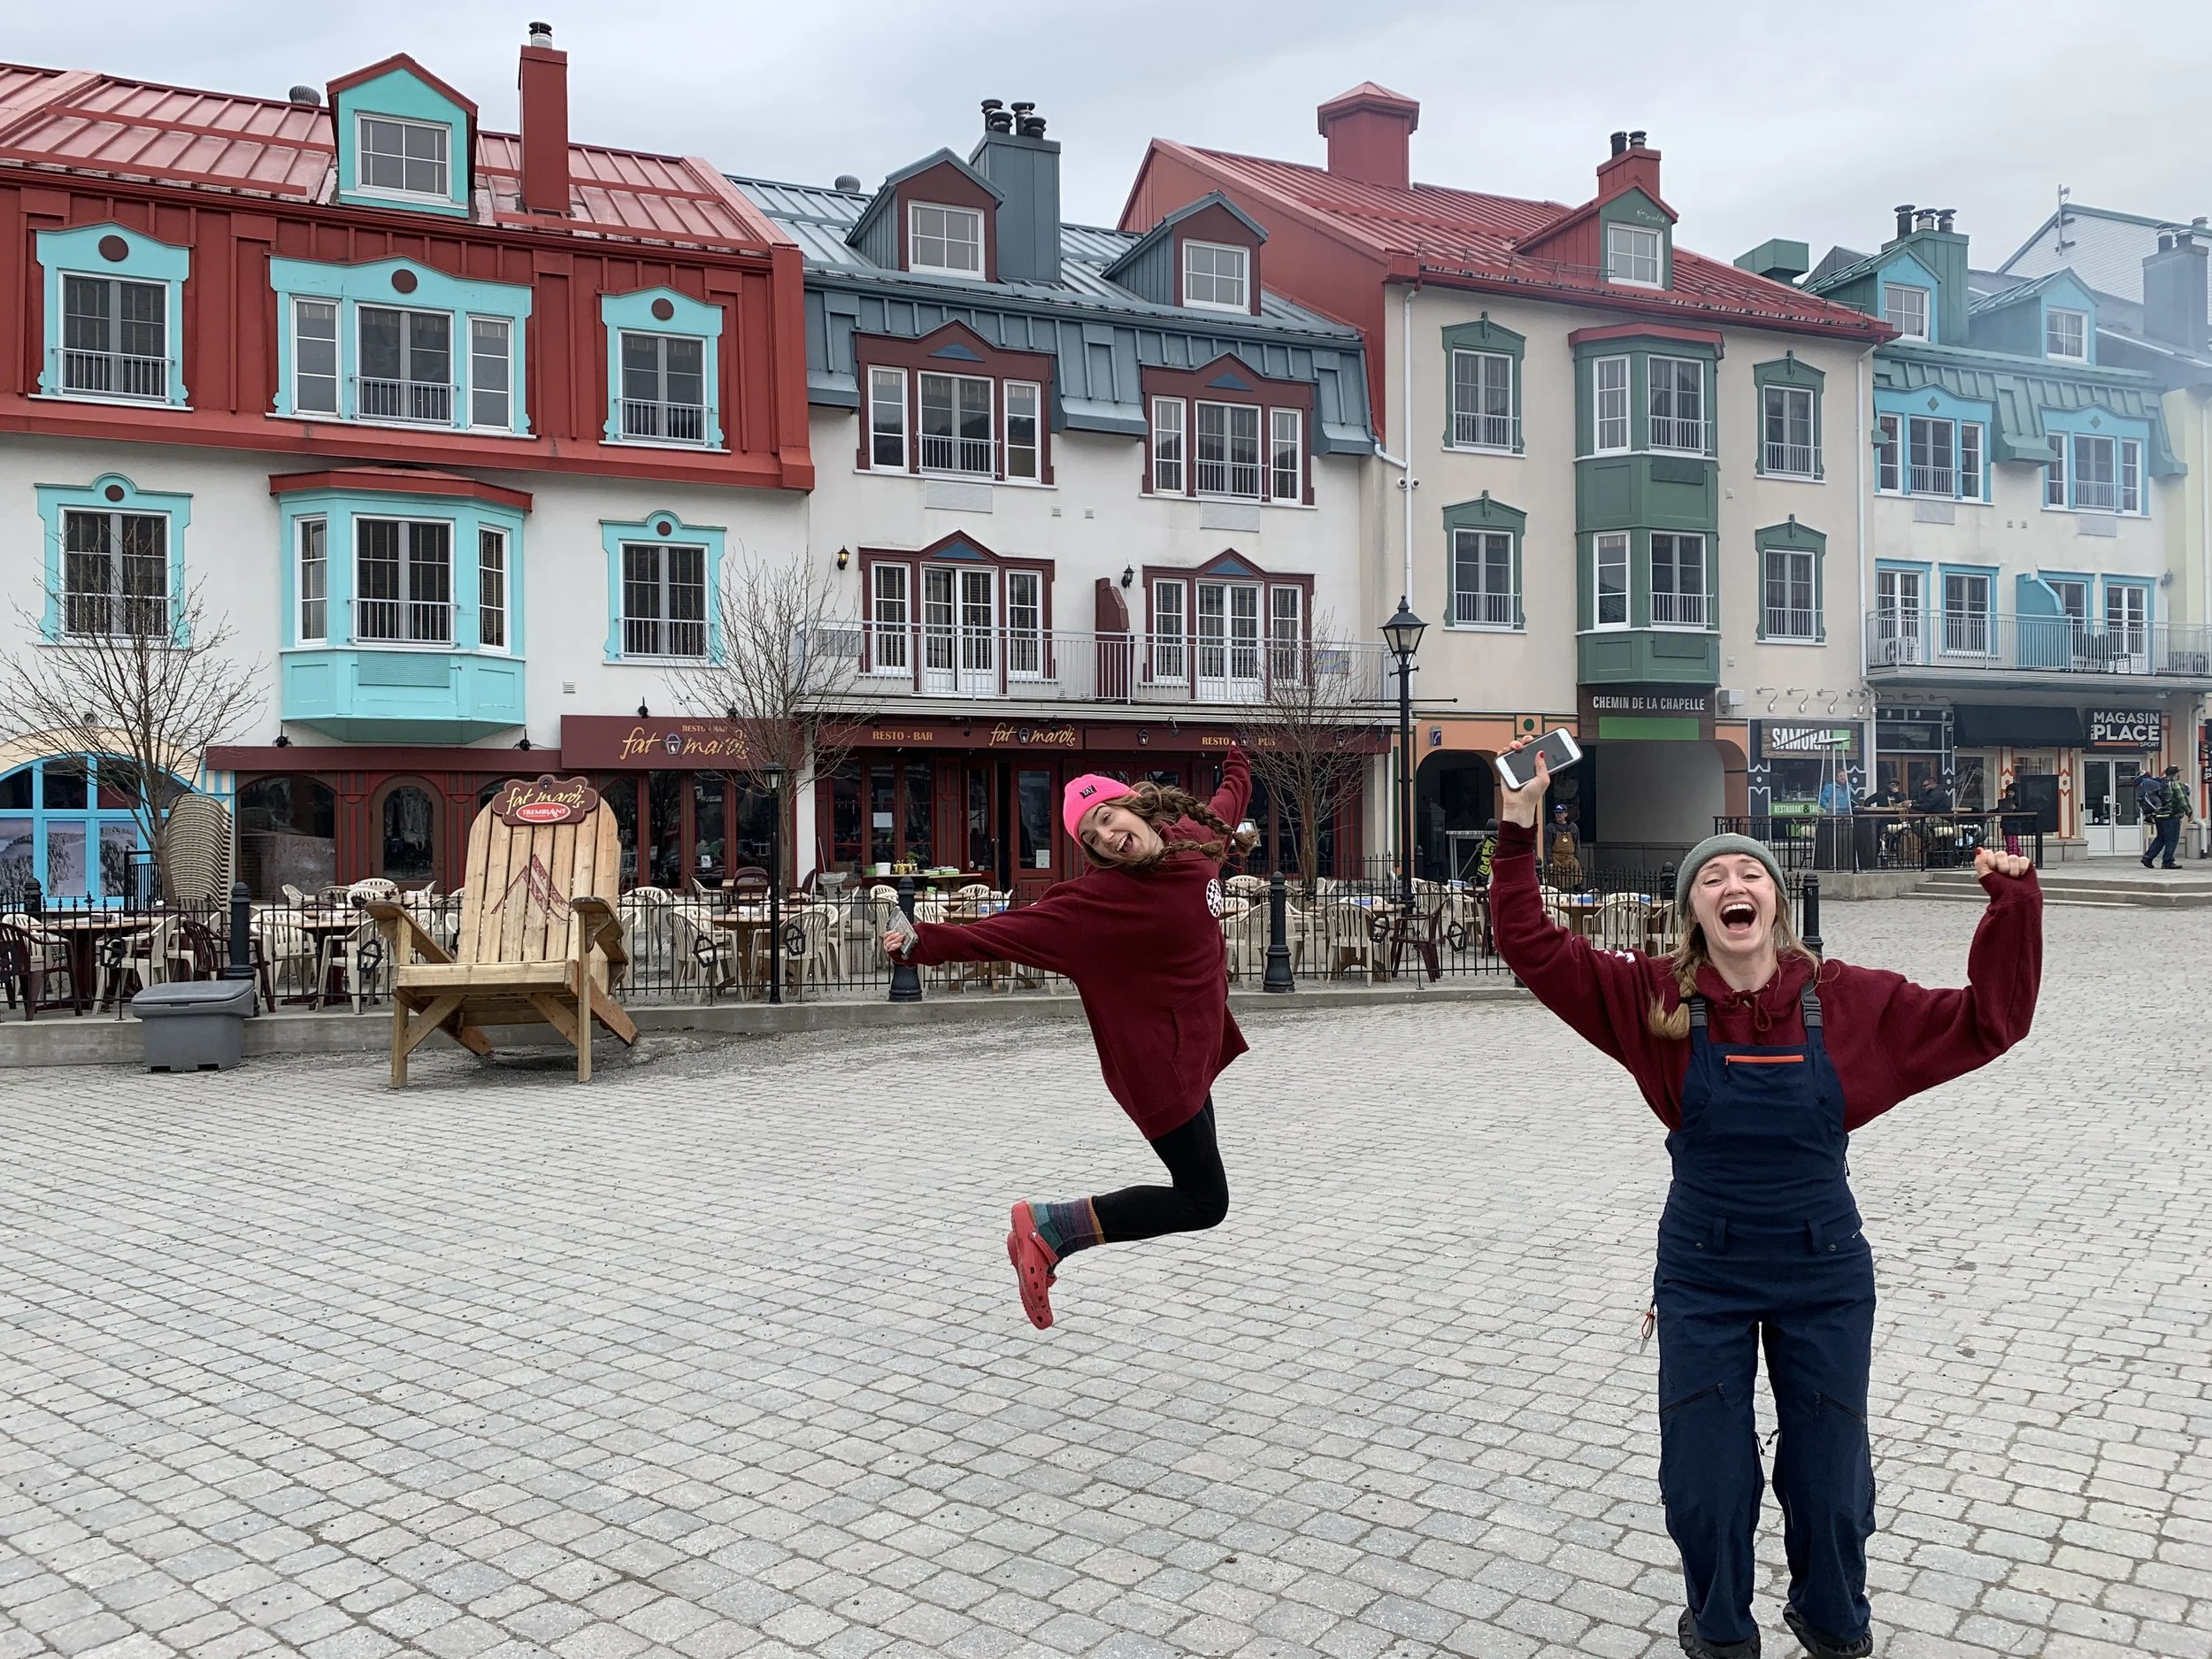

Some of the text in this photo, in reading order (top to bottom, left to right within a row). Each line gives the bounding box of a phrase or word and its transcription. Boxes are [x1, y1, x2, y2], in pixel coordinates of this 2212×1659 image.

[1593, 695, 1705, 710] CHEMIN DE LA CHAPELLE
[2093, 711, 2159, 725] MAGASIN
[872, 730, 904, 741] RESTO
[913, 731, 933, 741] BAR
[988, 722, 1017, 747] fat
[1772, 727, 1831, 750] SAMURAI
[2093, 724, 2160, 741] PLACE
[619, 726, 662, 760] fat
[1202, 736, 1230, 746] RESTO
[506, 787, 534, 815] fat
[522, 807, 566, 818] TREMBLANT
